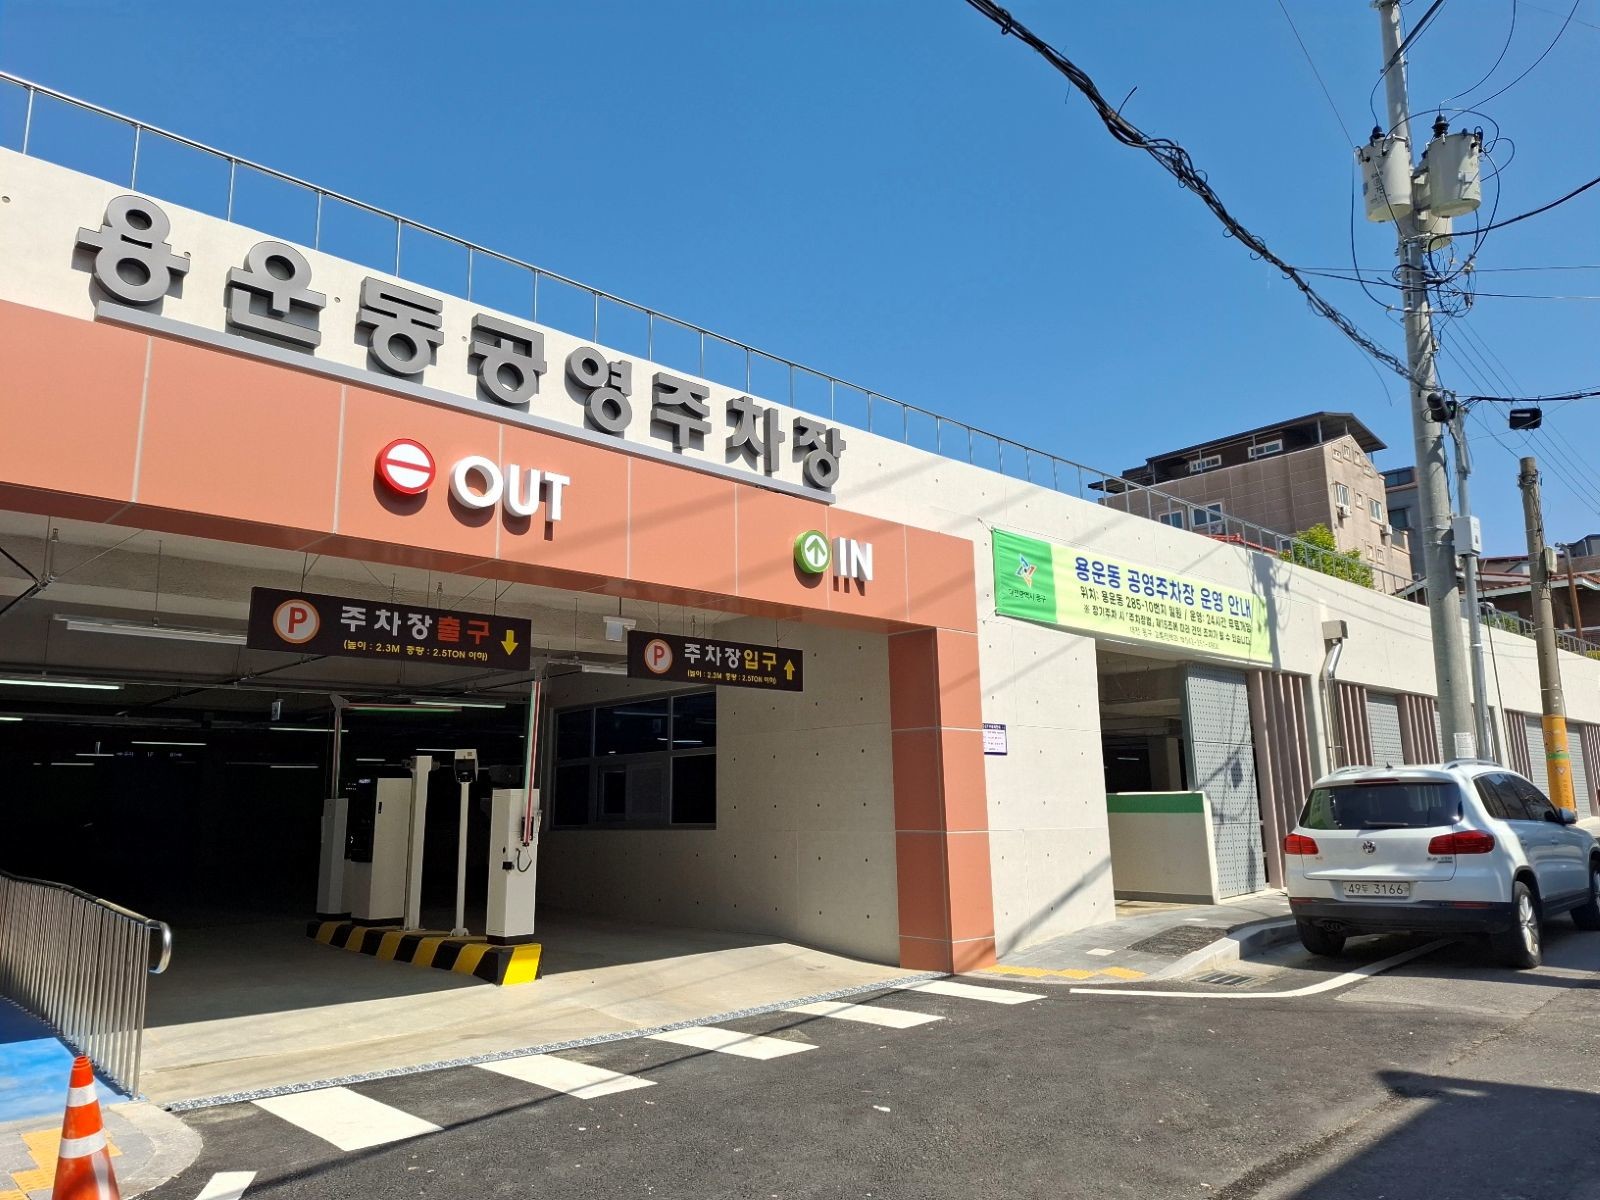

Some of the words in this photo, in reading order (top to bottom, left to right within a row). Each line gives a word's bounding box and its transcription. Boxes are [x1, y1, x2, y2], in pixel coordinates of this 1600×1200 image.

[76, 194, 847, 488] 용운동공영주차장
[449, 455, 570, 522] OUT
[832, 536, 873, 582] IN
[1075, 557, 1121, 589] 용운동
[1127, 569, 1195, 606] 공영주차장
[1200, 587, 1224, 613] 운영
[1228, 595, 1251, 618] 안내
[1080, 586, 1099, 602] 위치:
[1101, 590, 1124, 606] 용운동
[1125, 596, 1168, 616] 285-10번지
[1189, 610, 1204, 623] 운영:
[1206, 614, 1227, 629] 24시간
[288, 606, 308, 634] P
[343, 639, 366, 651] (높이
[375, 642, 400, 654] 2.3M
[406, 645, 425, 656] 중량
[433, 648, 466, 660] 2.5TON
[468, 650, 488, 662] 이하)
[653, 645, 665, 666] P
[1374, 883, 1403, 895] 3166
